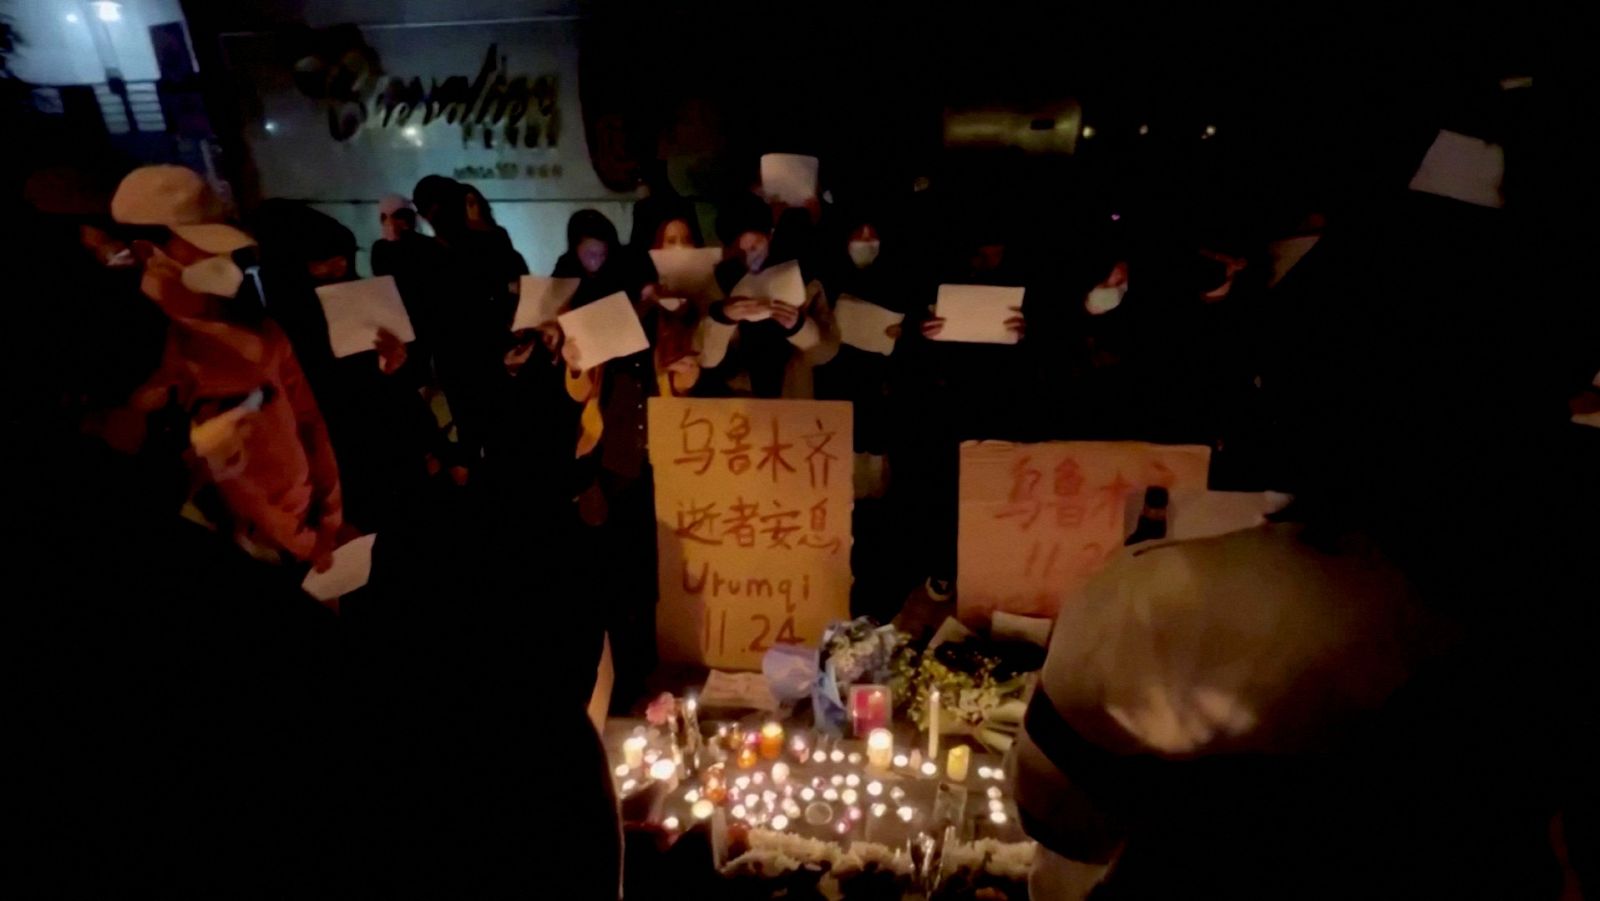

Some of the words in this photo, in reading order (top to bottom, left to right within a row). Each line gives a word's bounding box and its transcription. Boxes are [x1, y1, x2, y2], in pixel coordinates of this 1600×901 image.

[674, 408, 838, 488] 乌鲁木齐
[674, 496, 841, 554] 逝者安息
[681, 558, 810, 613] Urumqi
[704, 609, 806, 655] 11.24
